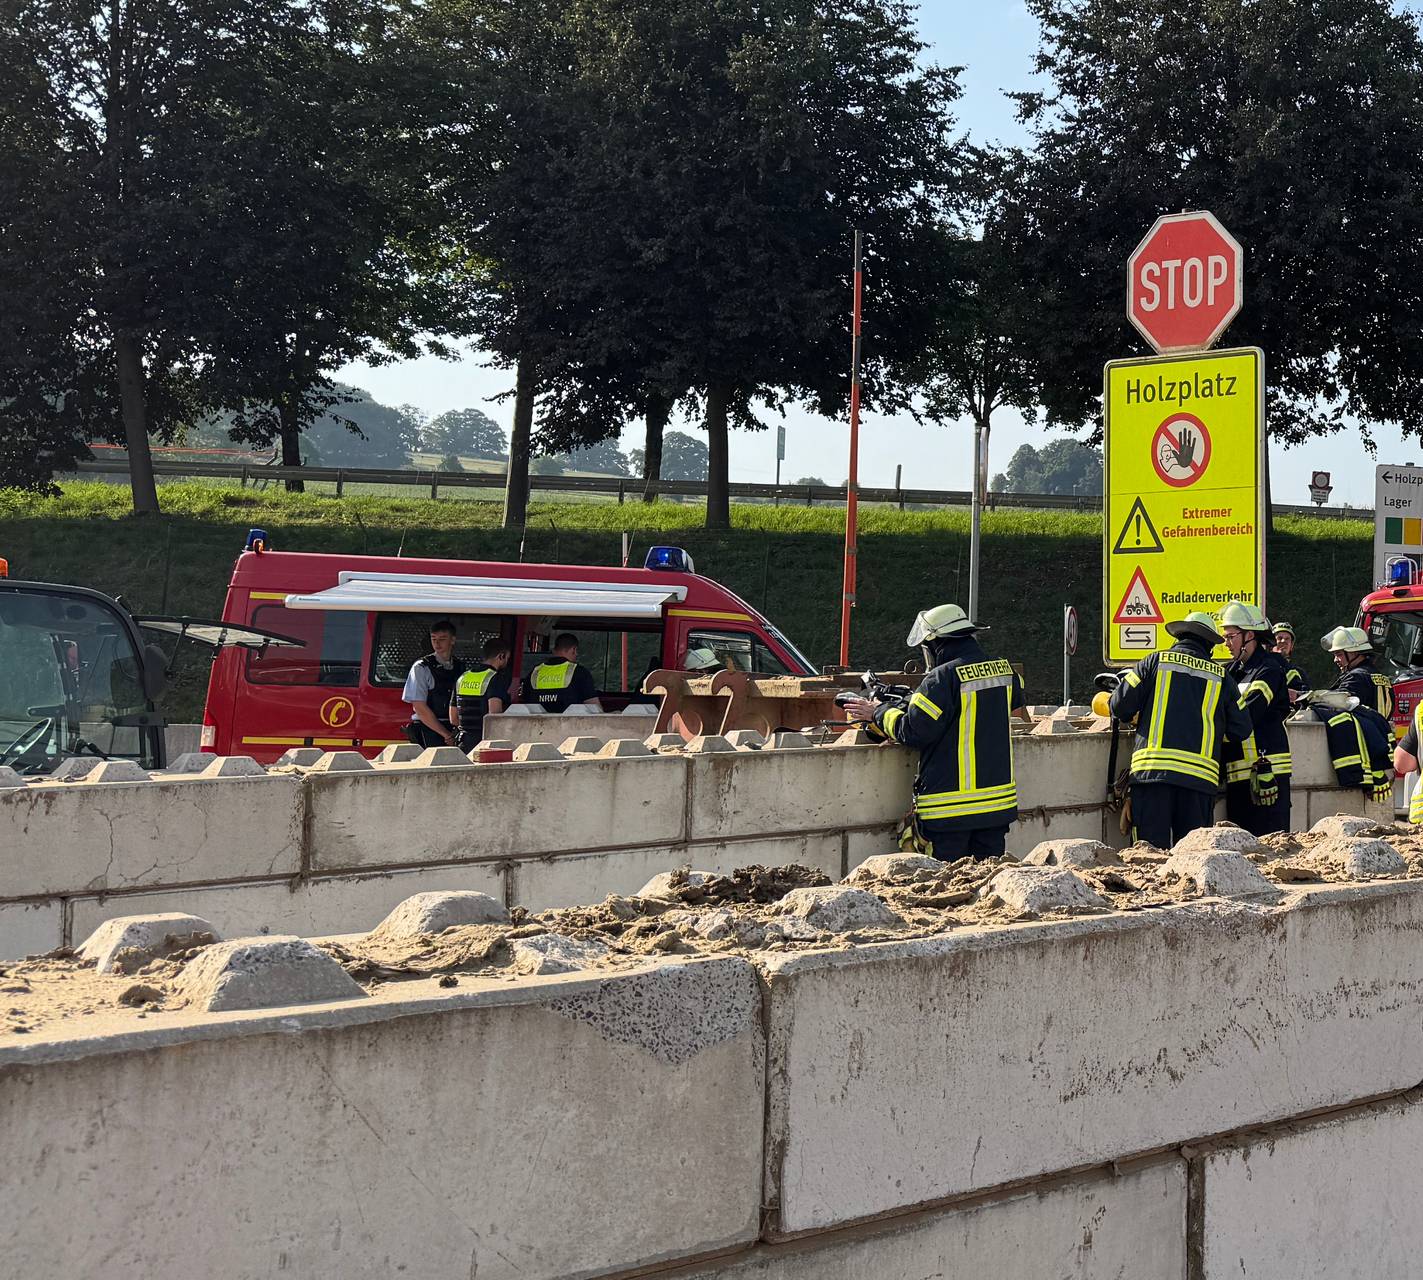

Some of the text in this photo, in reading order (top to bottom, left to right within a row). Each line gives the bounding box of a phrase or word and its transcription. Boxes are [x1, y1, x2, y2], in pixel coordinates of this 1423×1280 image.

[1140, 254, 1228, 312] STOP
[1126, 372, 1237, 407] Holzplatz
[1384, 496, 1412, 509] Lager
[1182, 507, 1232, 519] Extremer
[1162, 522, 1253, 538] Gefahrenbereich
[1161, 590, 1253, 603] Radladerverkehr
[958, 661, 1011, 680] FEUERWEHR
[1162, 653, 1223, 675] FEUERWEHR
[539, 695, 557, 703] NRW
